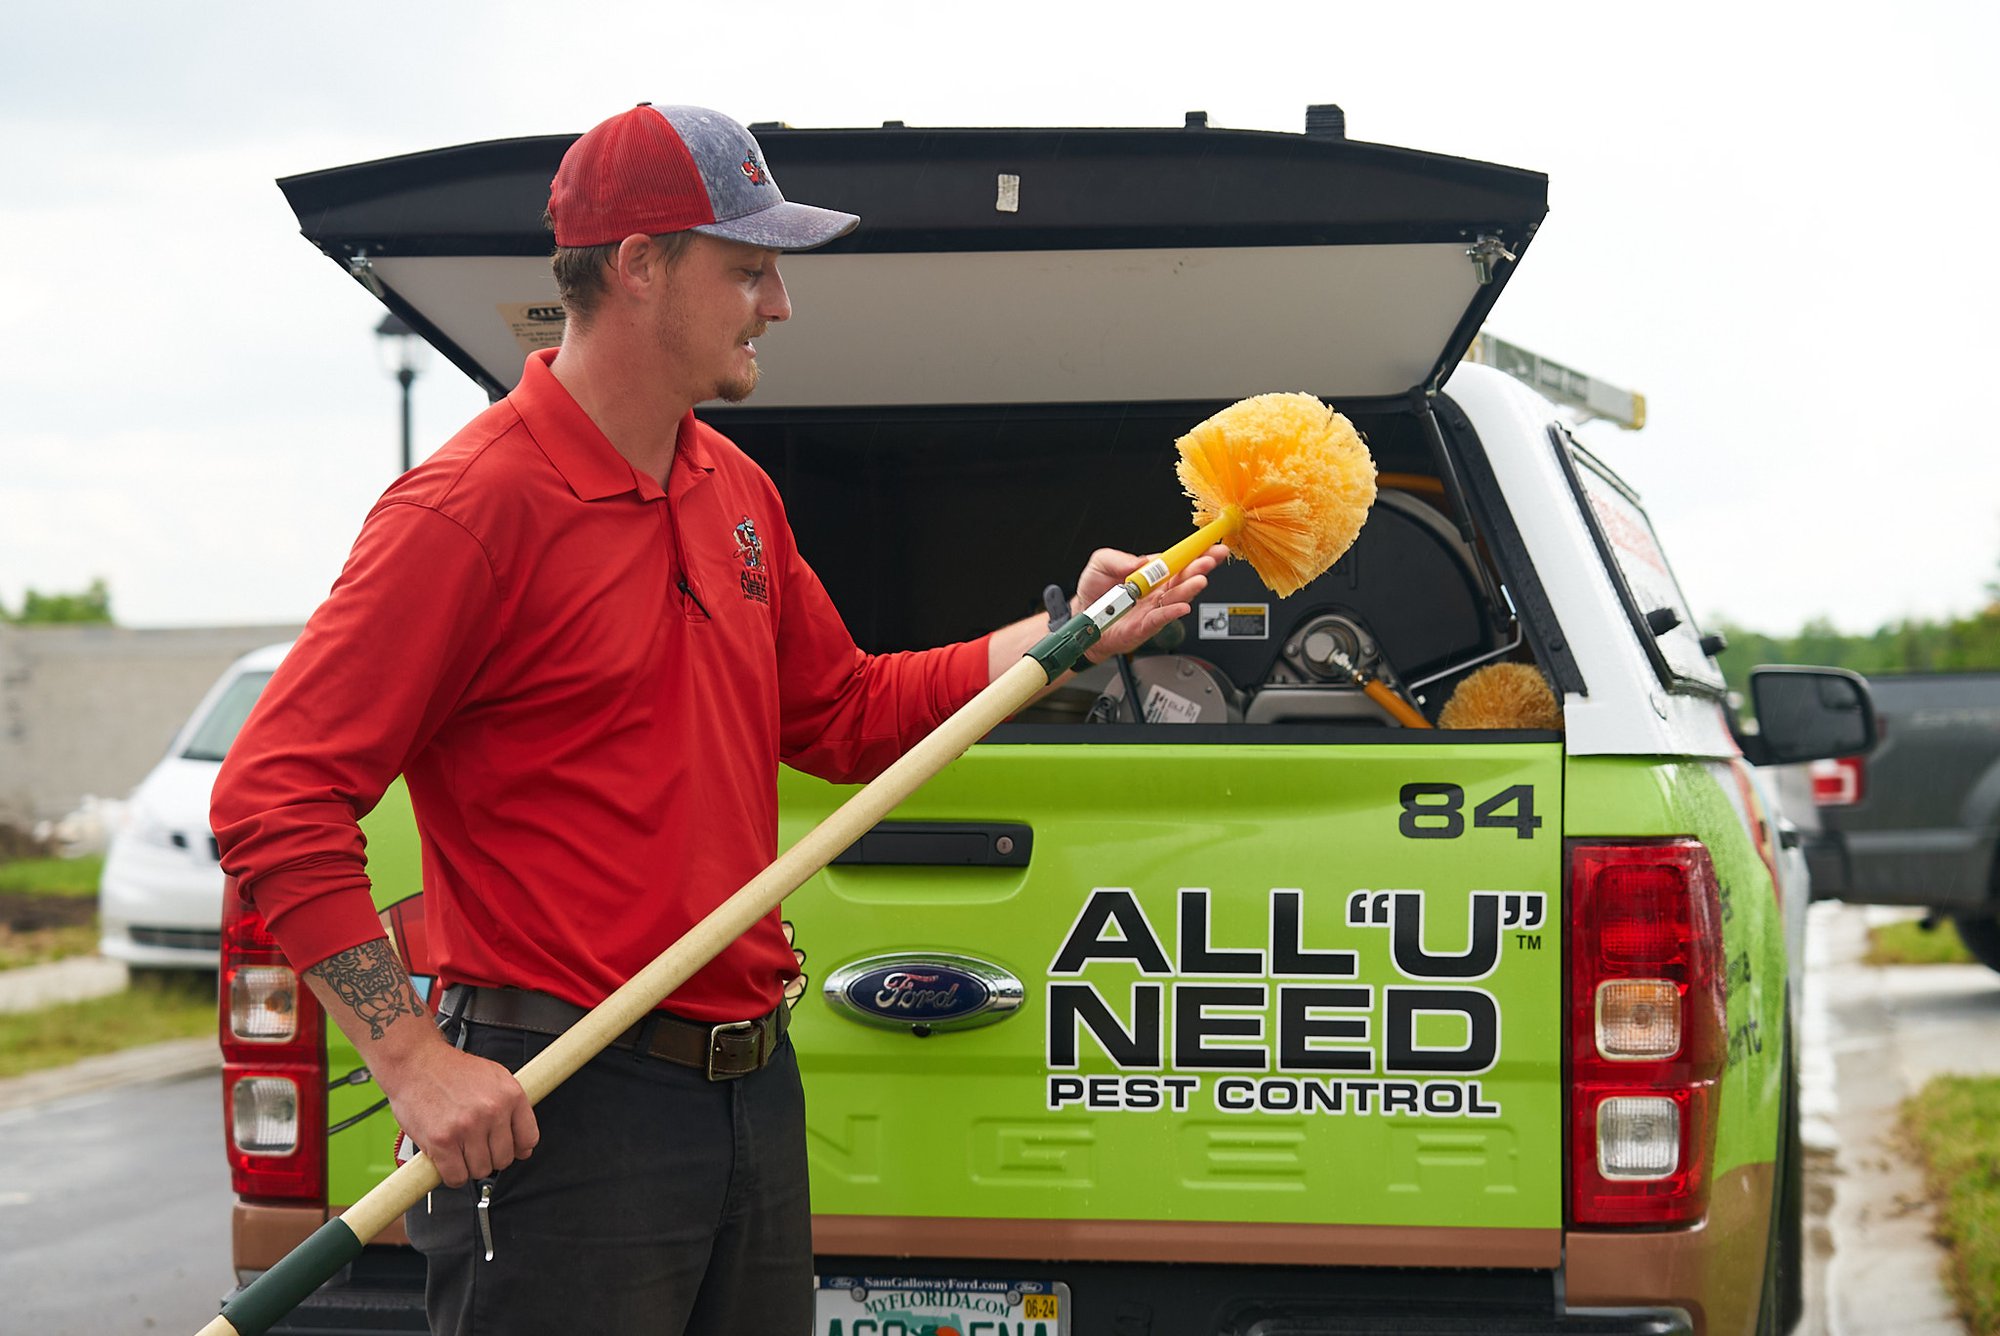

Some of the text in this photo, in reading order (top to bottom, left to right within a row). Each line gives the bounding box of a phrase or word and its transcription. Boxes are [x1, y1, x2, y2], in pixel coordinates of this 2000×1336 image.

[741, 581, 767, 599] NEED
[1399, 782, 1542, 839] 84
[1048, 889, 1357, 976] ALL
[875, 972, 961, 1009] Ford
[1048, 983, 1500, 1073] NEED
[1048, 1076, 1500, 1115] PEST CONTROL
[864, 1277, 1008, 1291] SamGallowayFord.com
[864, 1290, 1011, 1319] MYFLORIDA.COM
[1025, 1299, 1055, 1318] 06-24
